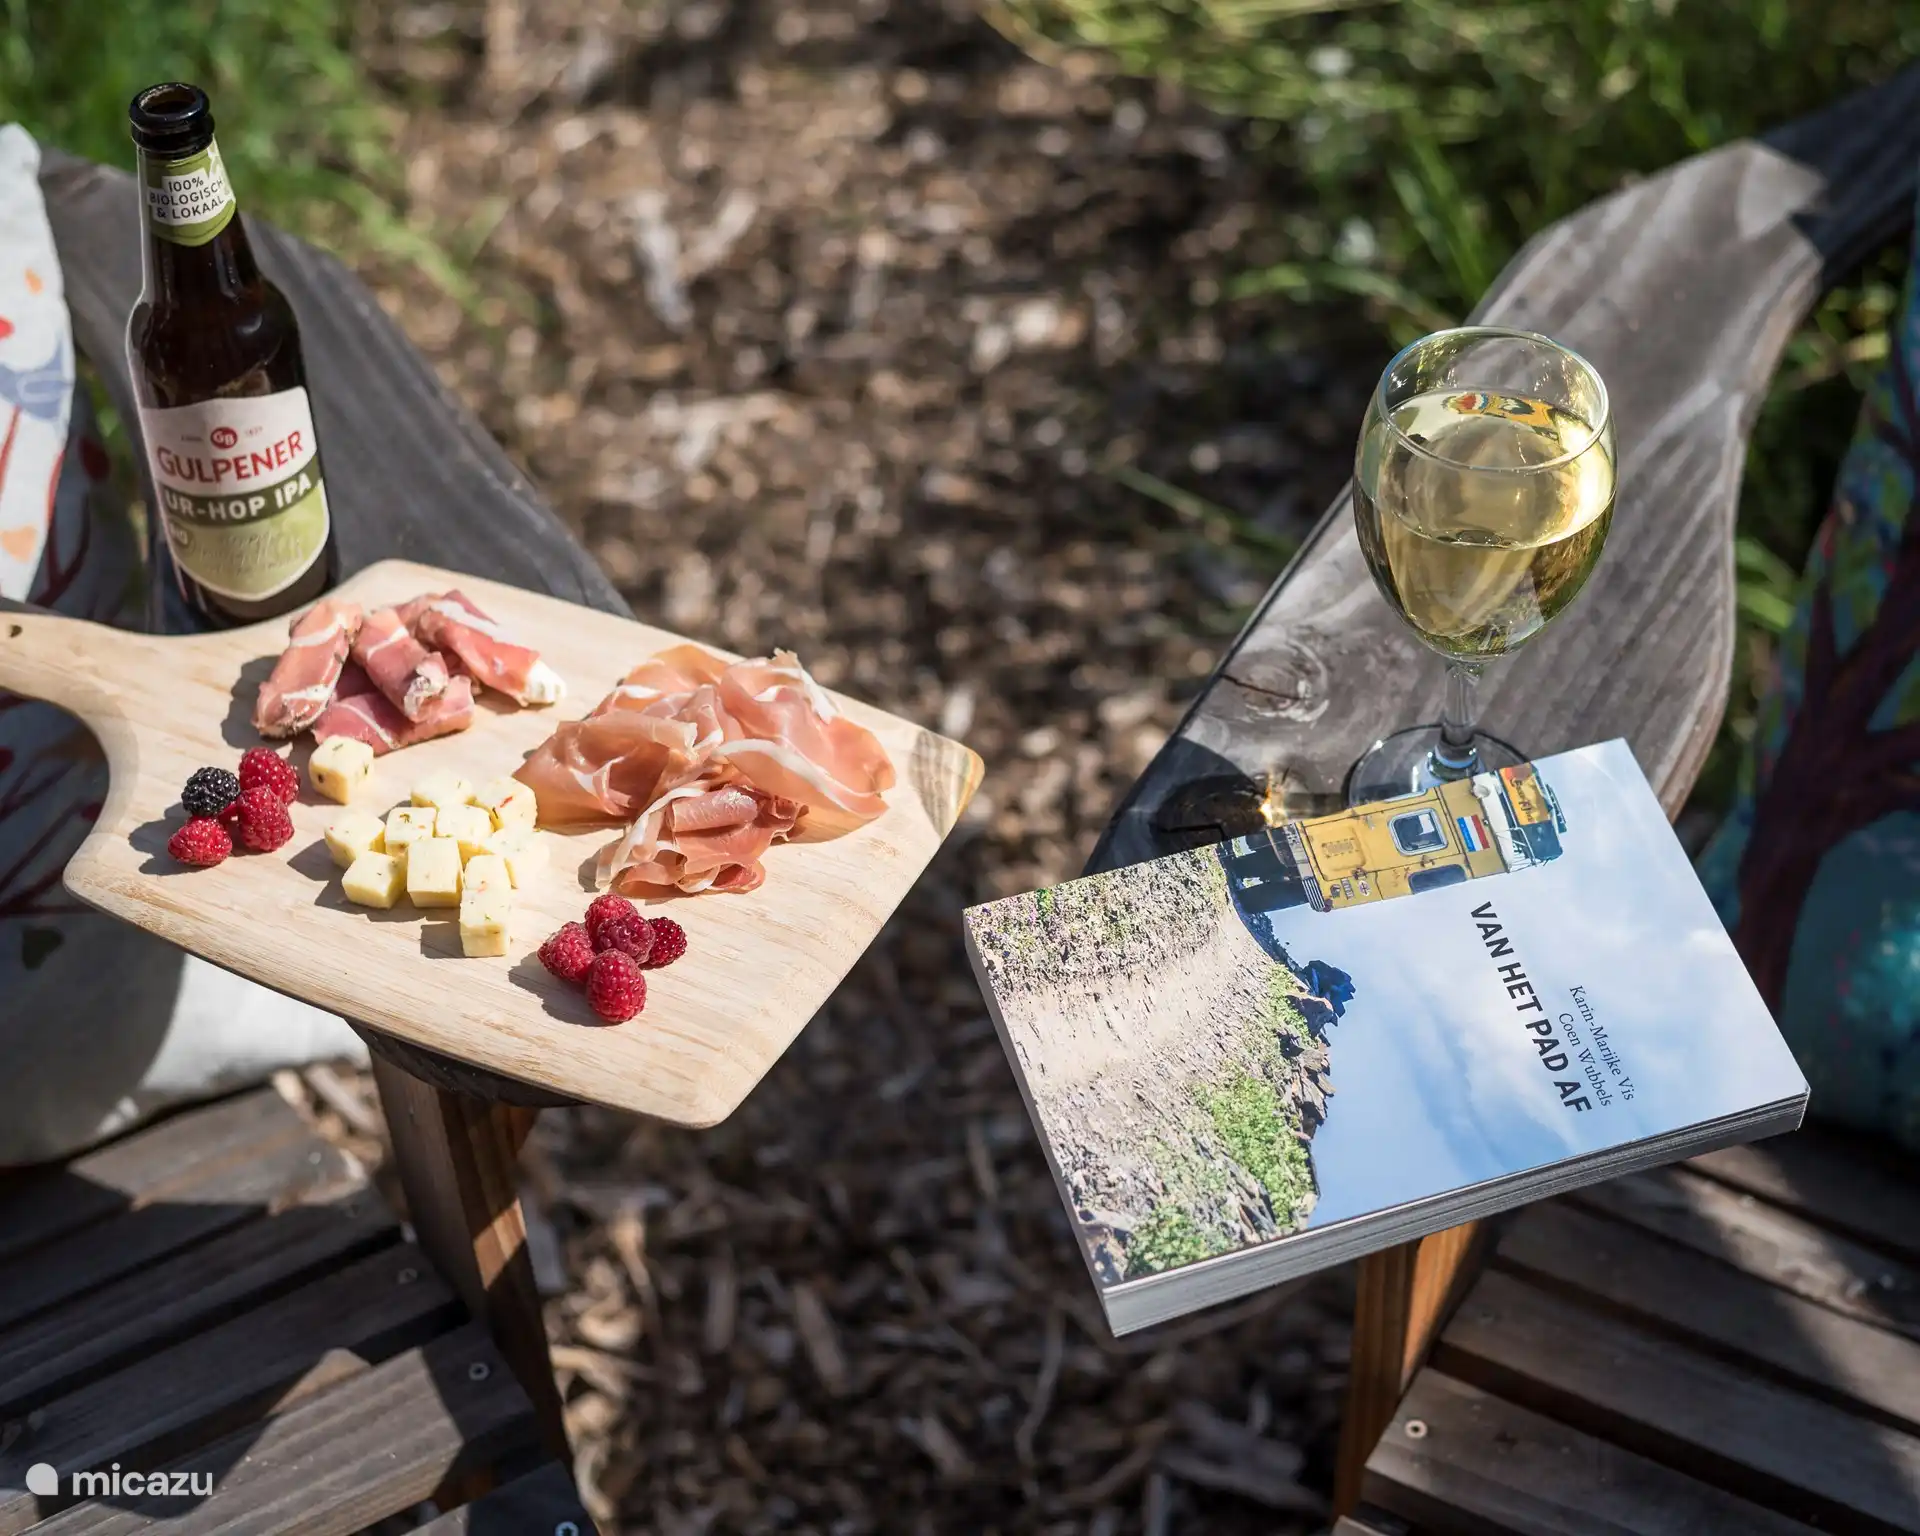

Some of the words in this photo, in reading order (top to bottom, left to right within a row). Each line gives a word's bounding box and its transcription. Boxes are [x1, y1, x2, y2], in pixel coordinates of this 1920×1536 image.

[149, 178, 223, 206] BIOLOGISCH
[157, 207, 166, 218] &
[172, 196, 224, 219] LOKAAL
[168, 176, 204, 193] 100%
[157, 431, 303, 484] GULPENER
[165, 489, 265, 520] UR-HOP
[274, 473, 311, 508] IPA
[1471, 901, 1514, 958] VAN
[1497, 962, 1543, 1012] HET
[1525, 1018, 1569, 1072] PAD
[1553, 1081, 1592, 1112] AF
[1559, 1012, 1581, 1047] Coen
[1578, 1047, 1612, 1107] Wubbels
[1569, 985, 1622, 1076] Karin-Marijke
[1619, 1076, 1634, 1100] Vis
